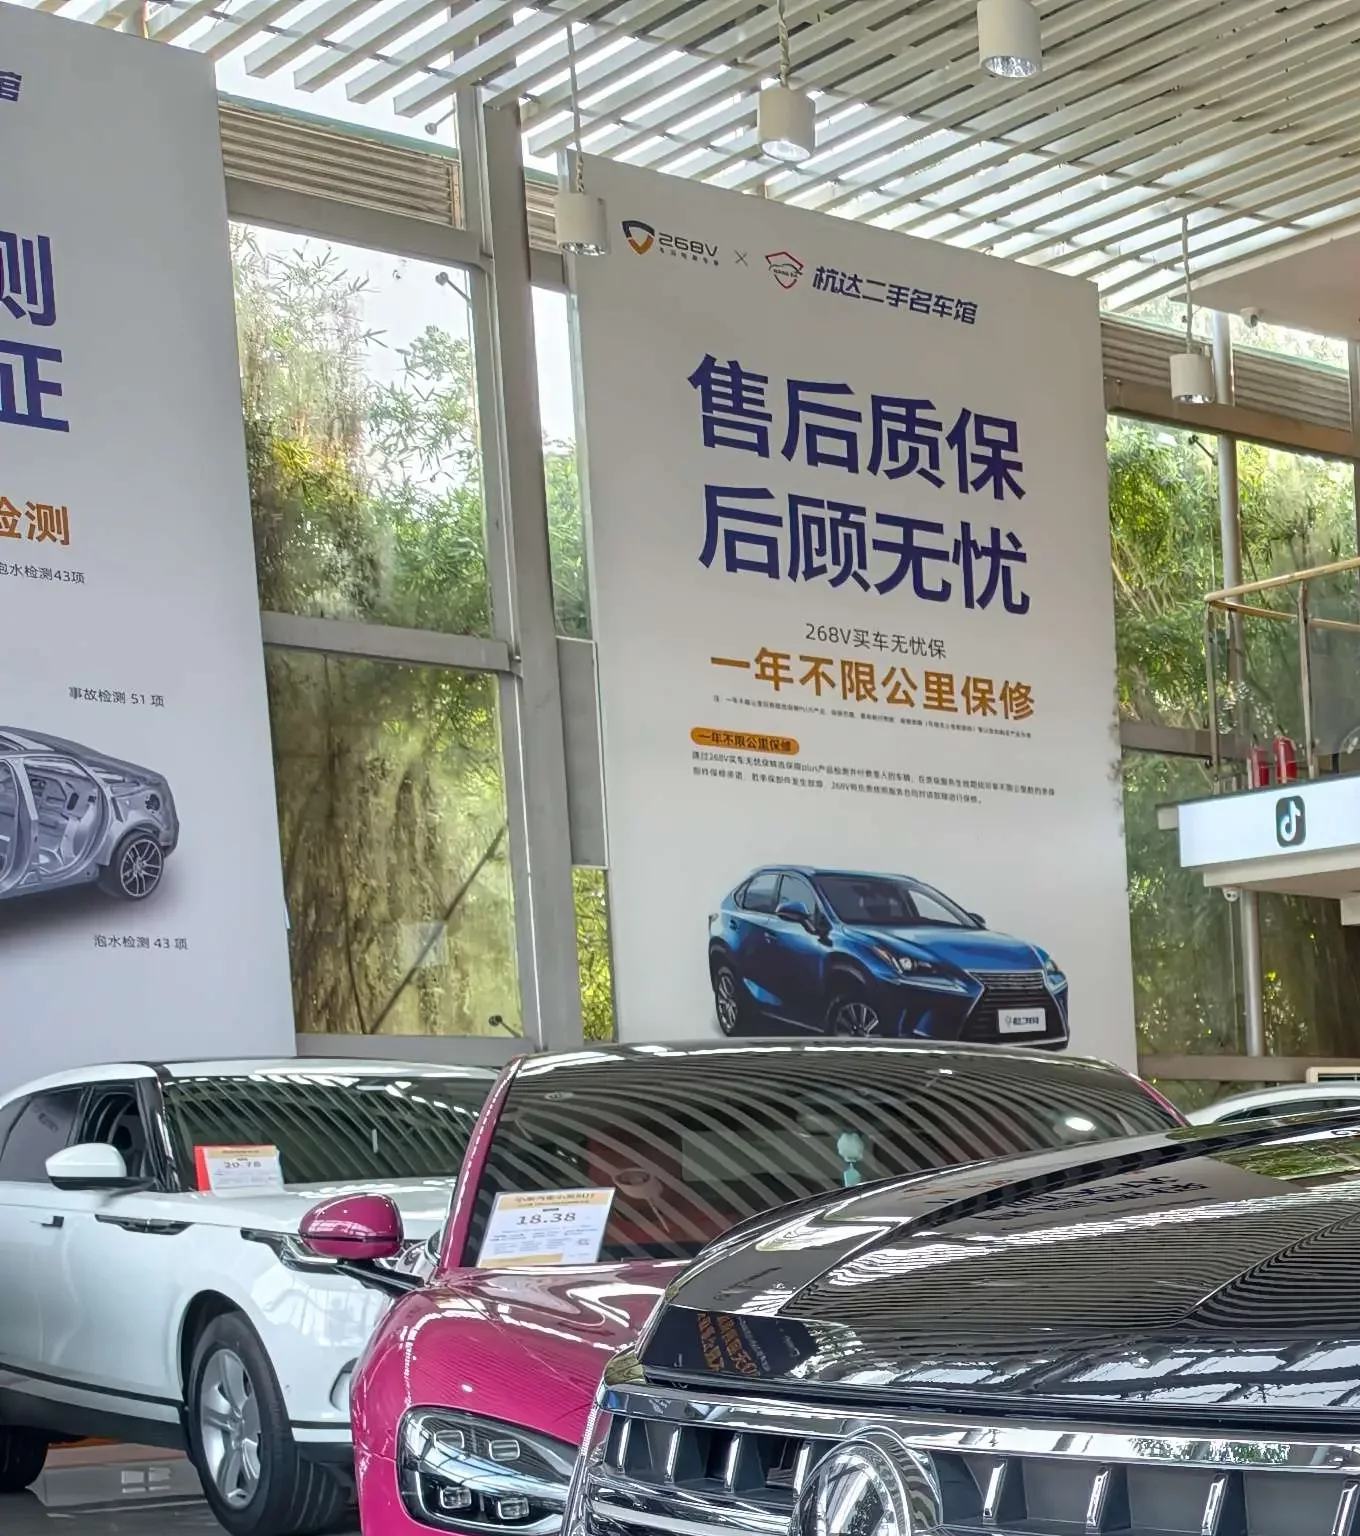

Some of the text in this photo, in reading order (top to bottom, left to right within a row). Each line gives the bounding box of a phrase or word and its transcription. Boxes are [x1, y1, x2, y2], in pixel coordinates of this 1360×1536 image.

[659, 232, 717, 257] 268V
[812, 265, 978, 325] 杭达二手名车馆
[687, 354, 1026, 501] 售后质保
[699, 484, 1031, 616] 后顾无忧
[804, 623, 947, 659] 268V买车无忧保
[69, 685, 165, 708] 事故检测 51 项
[710, 646, 1036, 721] 一年不限公里保修
[697, 732, 792, 753] 一年不限公里保修
[94, 934, 188, 951] 泡水检测 43 项
[516, 1212, 576, 1226] 18.38
